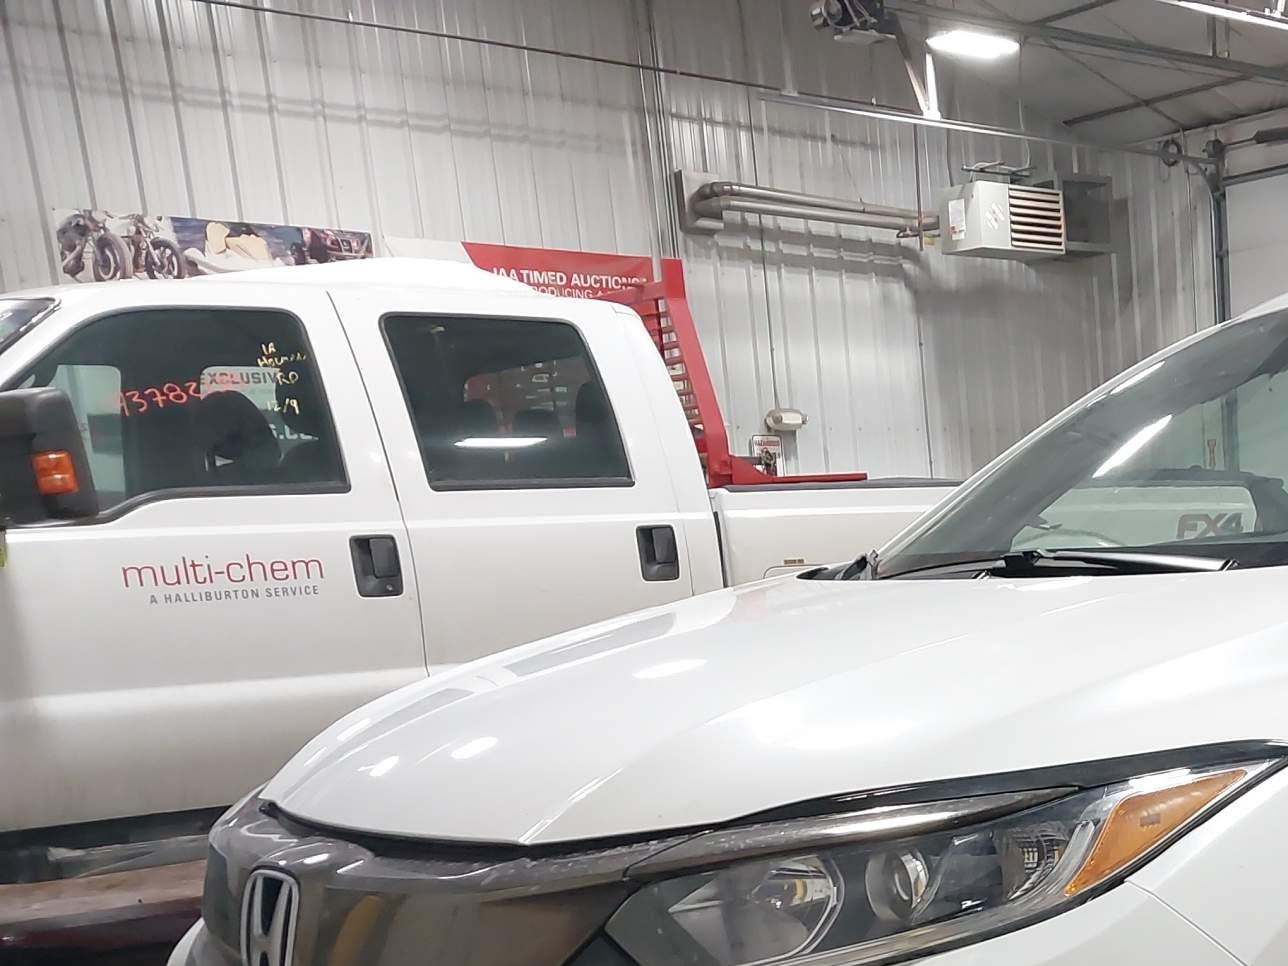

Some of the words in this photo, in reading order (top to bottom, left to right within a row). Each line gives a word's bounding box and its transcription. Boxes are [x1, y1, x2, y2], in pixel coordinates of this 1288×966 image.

[520, 269, 567, 286] TIMED
[1175, 513, 1242, 540] FX4
[122, 553, 325, 588] multi-chem
[149, 594, 159, 605] A
[164, 589, 260, 604] HALLIBURTON
[265, 584, 320, 598] SERVICE
